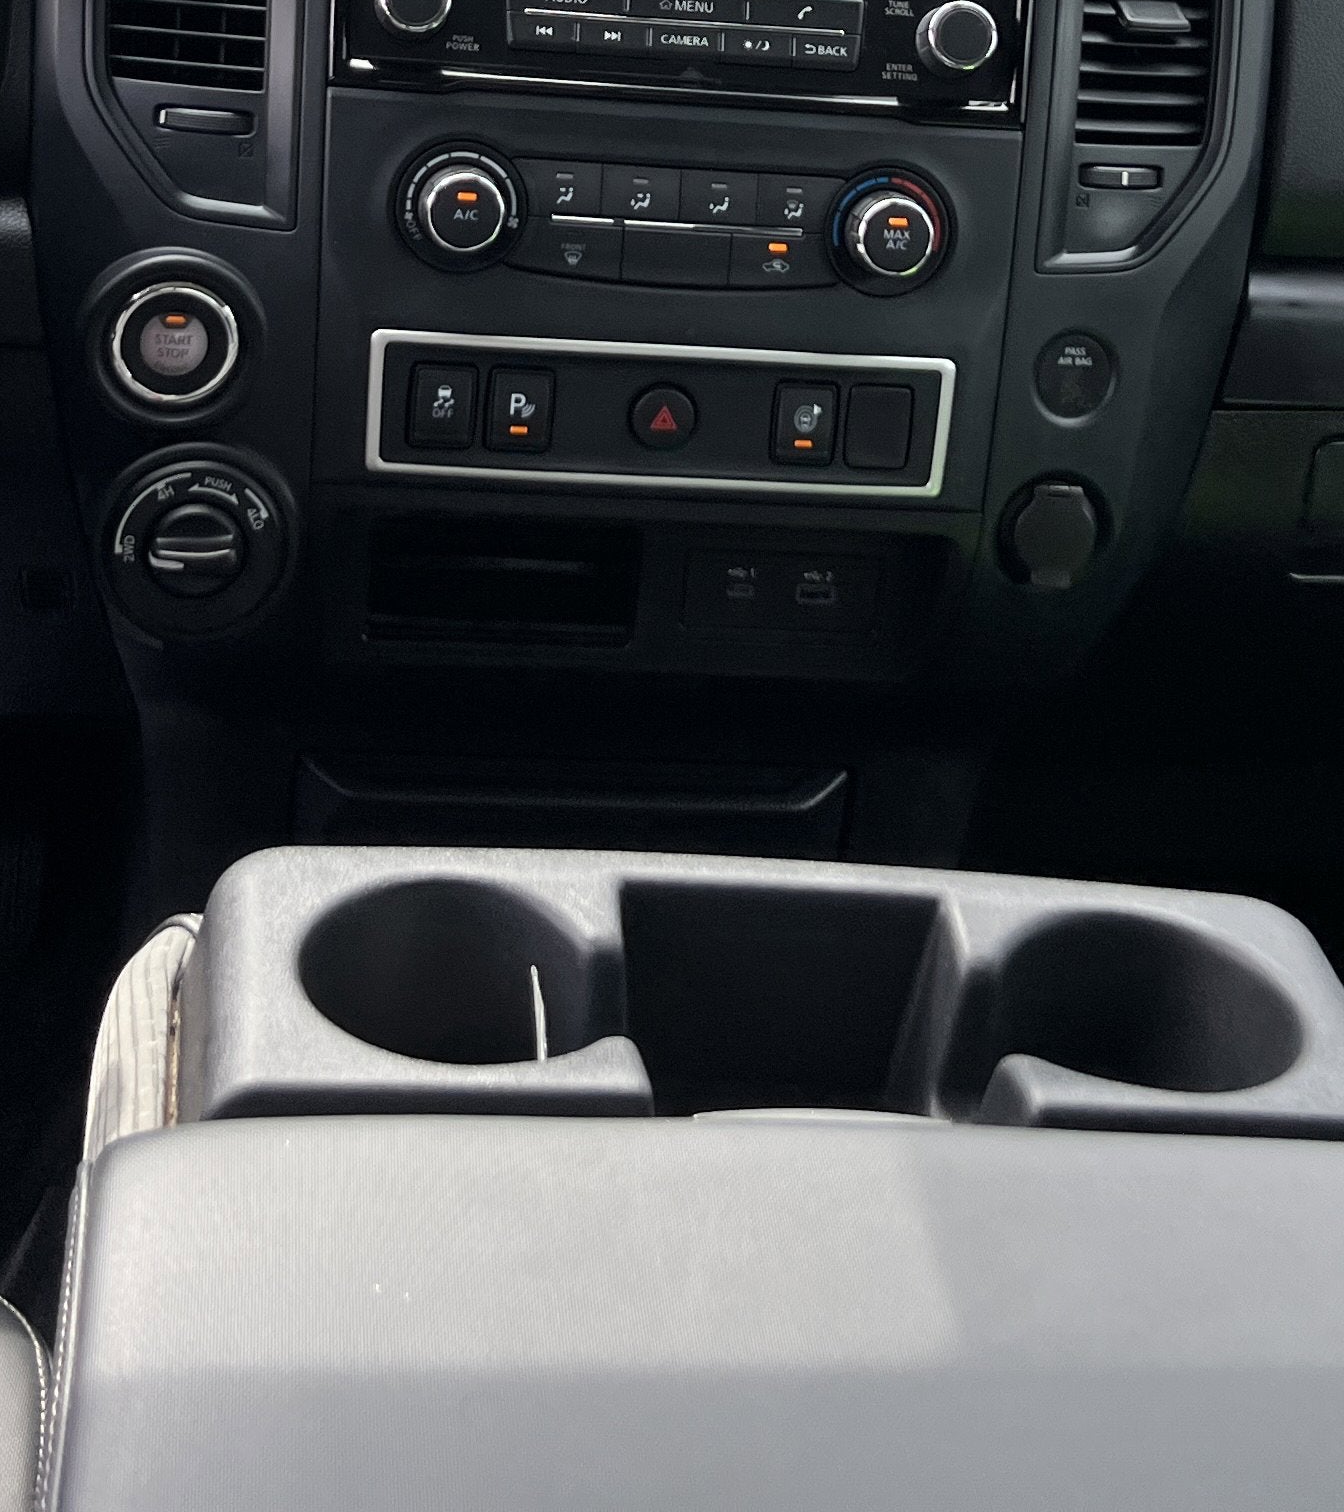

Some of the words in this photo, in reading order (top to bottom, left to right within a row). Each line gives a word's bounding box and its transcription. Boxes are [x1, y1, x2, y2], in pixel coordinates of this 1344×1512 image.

[674, 0, 714, 14] MENU
[888, 0, 910, 9] TUNE
[884, 6, 915, 17] SCROLL
[446, 41, 480, 51] POWER
[660, 34, 709, 47] CAMERA
[817, 45, 848, 57] BACK
[886, 62, 913, 73] ENTER
[882, 71, 918, 82] SETTING
[454, 208, 479, 221] A/C
[405, 220, 421, 241] OFF
[883, 229, 910, 240] MAX
[561, 242, 586, 251] FRONT
[885, 240, 908, 250] A/C
[155, 334, 194, 346] START
[157, 348, 190, 359] STOP
[1064, 346, 1086, 356] PASS
[1057, 356, 1073, 366] AIR
[1075, 356, 1093, 366] BAG
[510, 393, 527, 416] P
[432, 408, 454, 419] OFF
[204, 476, 232, 491] PUSH
[157, 486, 175, 500] 4H
[247, 508, 265, 530] 4LO
[123, 535, 135, 563] 2WD
